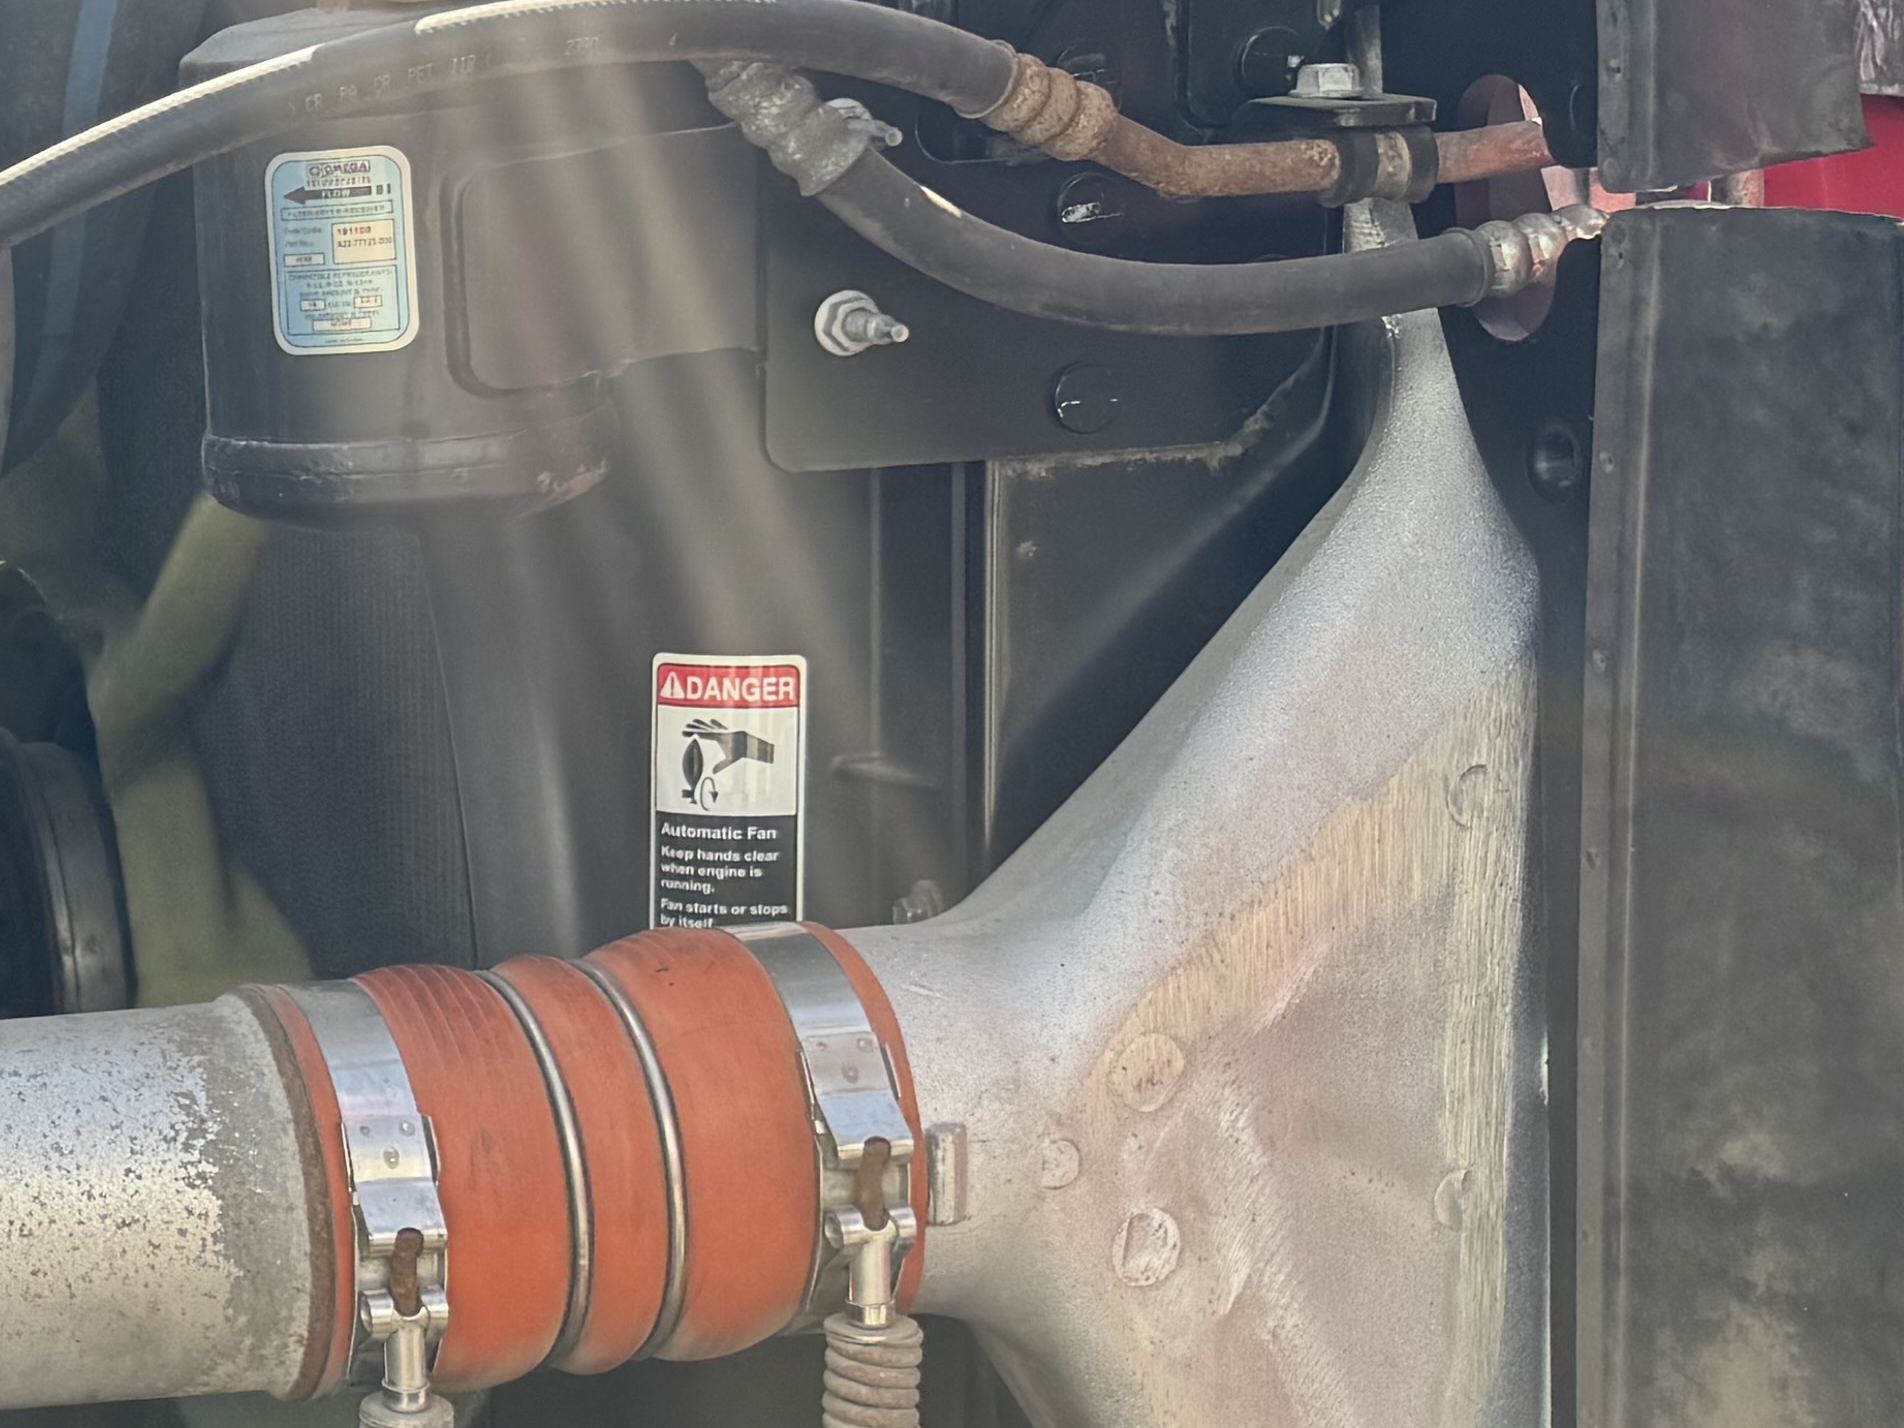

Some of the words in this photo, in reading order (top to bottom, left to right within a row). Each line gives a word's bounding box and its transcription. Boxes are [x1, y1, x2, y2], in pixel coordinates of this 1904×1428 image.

[686, 676, 795, 701] DANGER
[661, 822, 742, 840] Automatic
[747, 827, 777, 840] Fan
[661, 846, 694, 861] Keep
[697, 848, 741, 862] hands
[744, 850, 780, 862] clear
[661, 863, 694, 876] when
[698, 866, 745, 880] engine
[750, 865, 763, 877] is
[661, 879, 715, 895] running.
[661, 898, 683, 912] Fan
[685, 901, 727, 915] starts
[731, 904, 747, 915] or
[750, 903, 788, 917] stops
[660, 914, 676, 927] by
